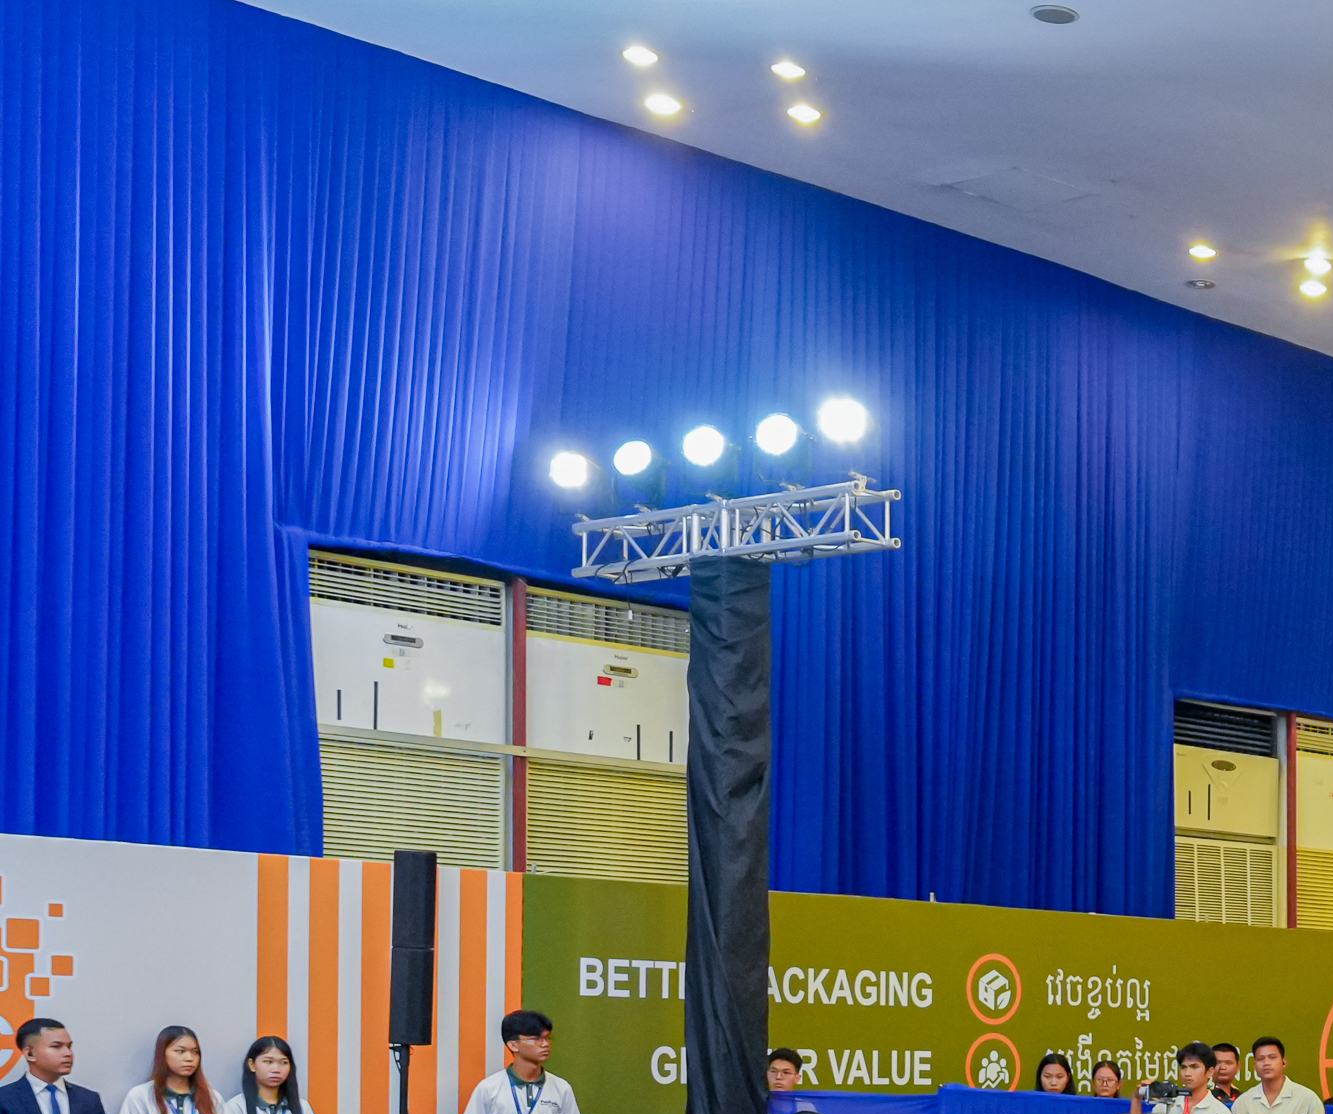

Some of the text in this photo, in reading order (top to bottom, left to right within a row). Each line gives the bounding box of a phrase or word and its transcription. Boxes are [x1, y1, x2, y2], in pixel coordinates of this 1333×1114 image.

[579, 957, 933, 1008] BETT ACKAGING
[828, 1049, 932, 1086] VALUE
